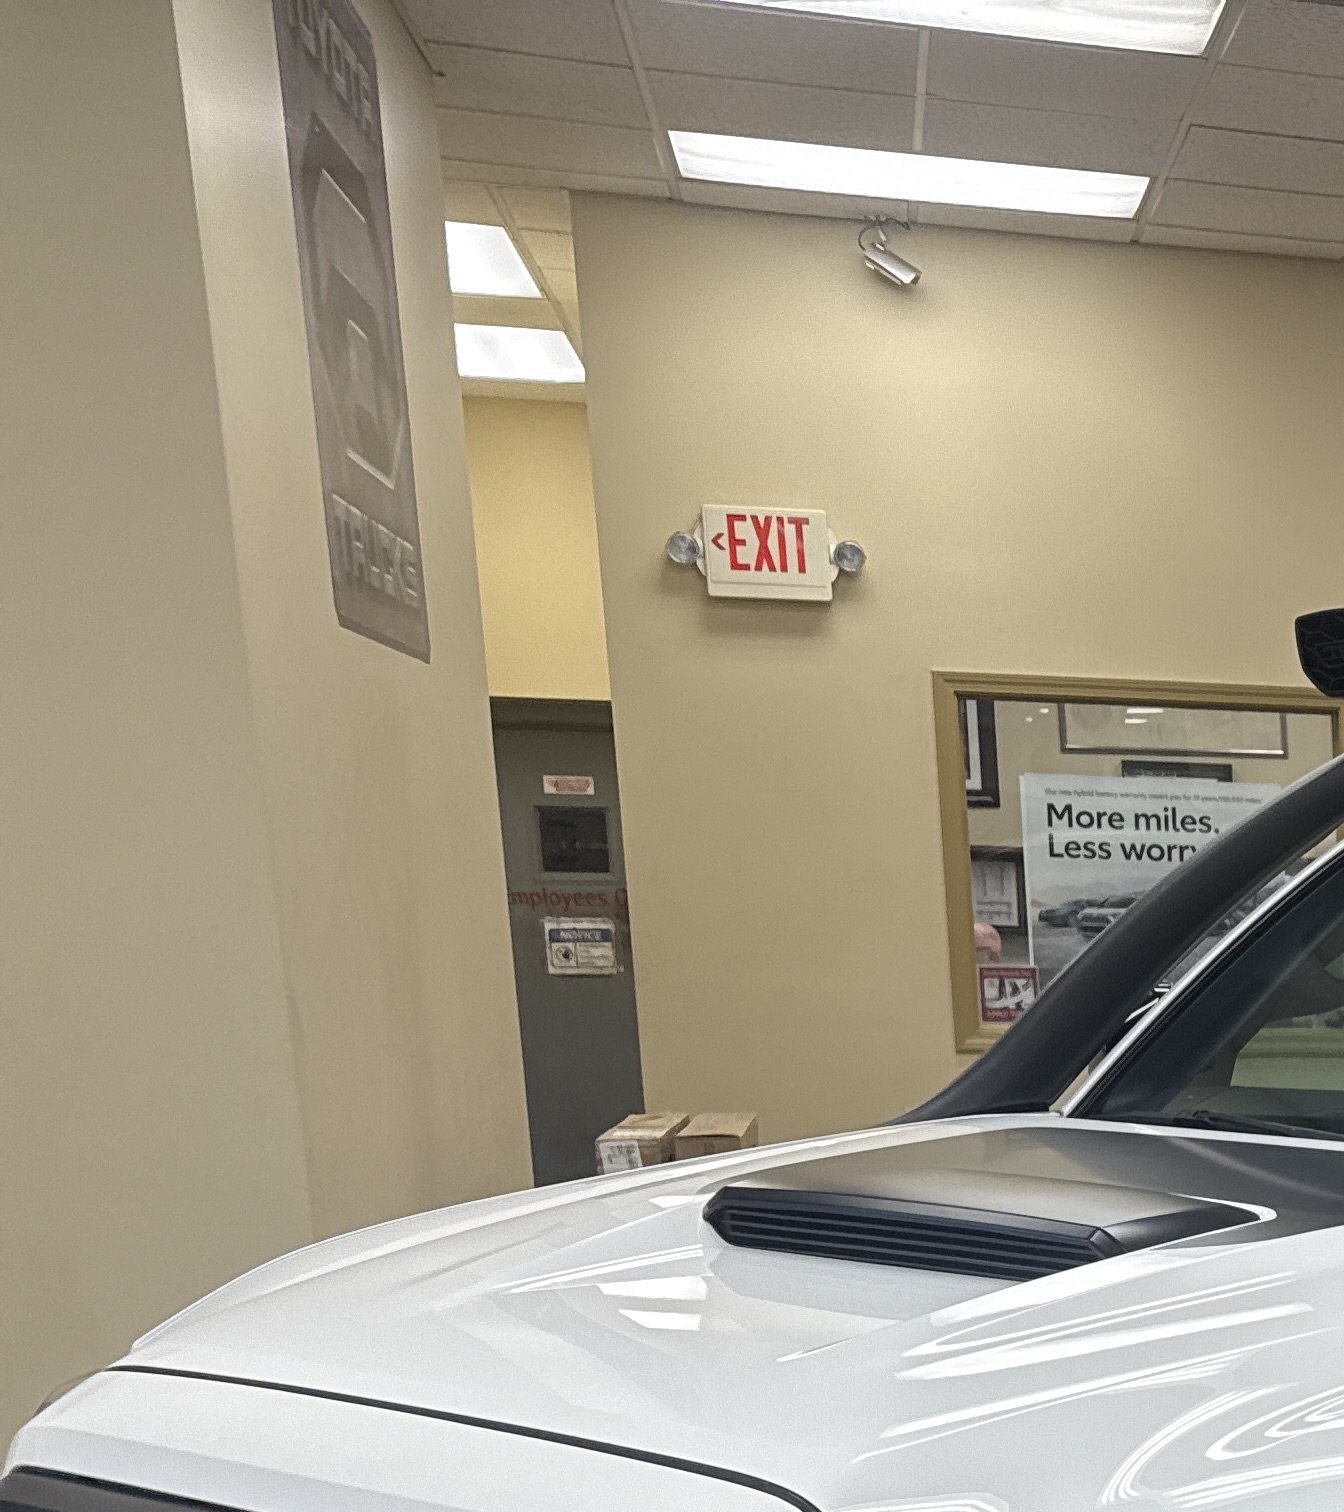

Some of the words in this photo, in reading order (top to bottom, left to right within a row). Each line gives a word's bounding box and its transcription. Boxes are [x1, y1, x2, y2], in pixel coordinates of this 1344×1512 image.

[726, 513, 809, 574] EXIT
[1046, 802, 1125, 830] More
[1134, 806, 1220, 834] miles.
[1048, 833, 1112, 860] Less
[1120, 842, 1197, 862] worr
[510, 887, 608, 912] mployees
